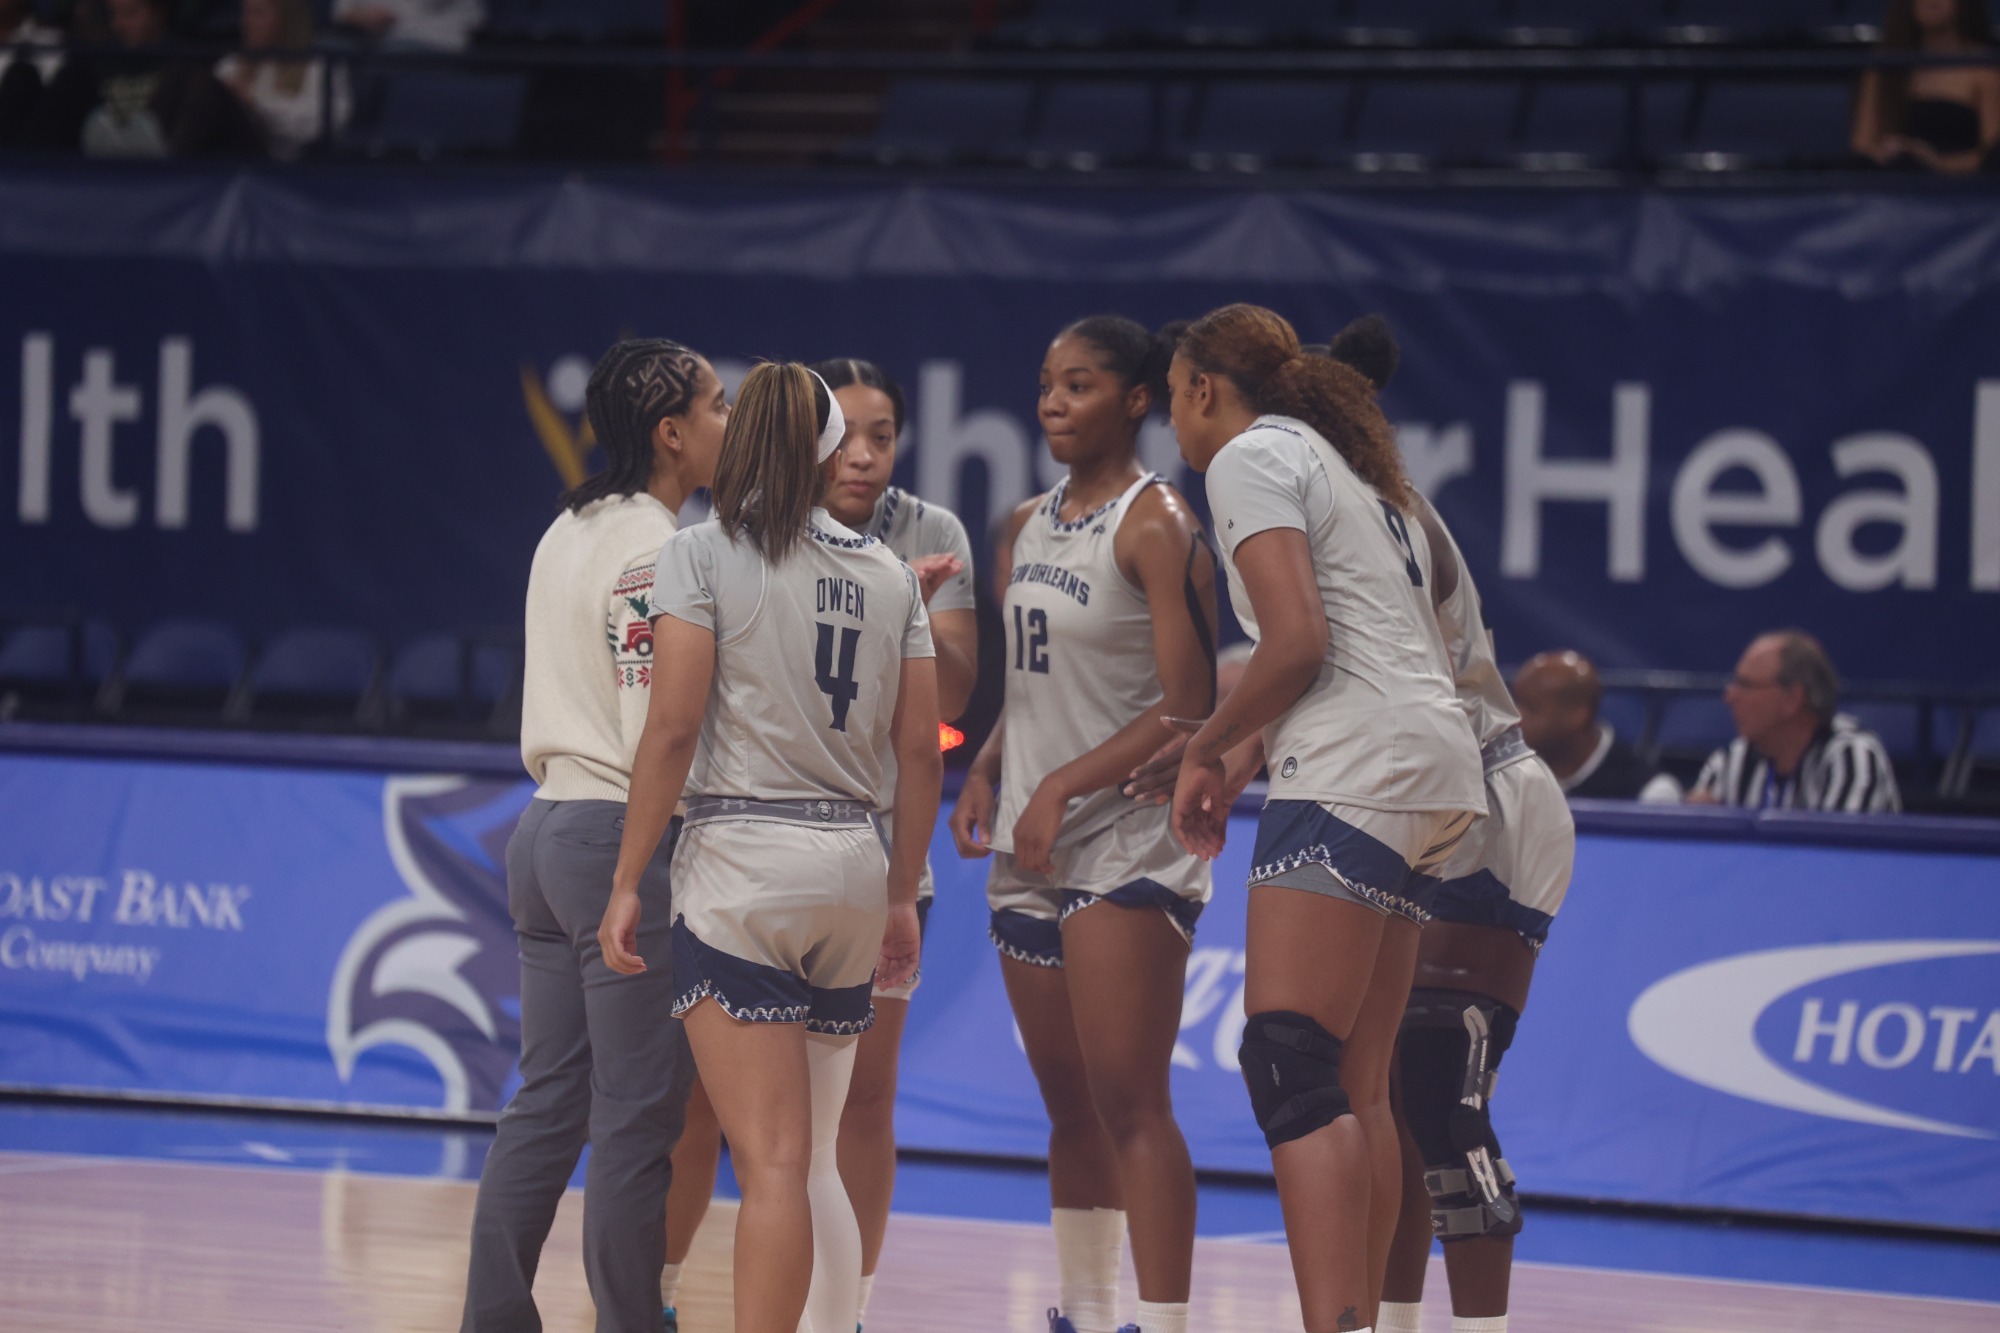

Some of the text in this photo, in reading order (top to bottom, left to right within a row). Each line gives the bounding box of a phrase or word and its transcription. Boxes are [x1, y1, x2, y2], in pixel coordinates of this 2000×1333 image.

[816, 576, 865, 622] OWEN
[1027, 564, 1090, 607] ORLEANS
[1013, 604, 1049, 675] 12
[814, 620, 863, 733] 4
[0, 923, 162, 985] Company
